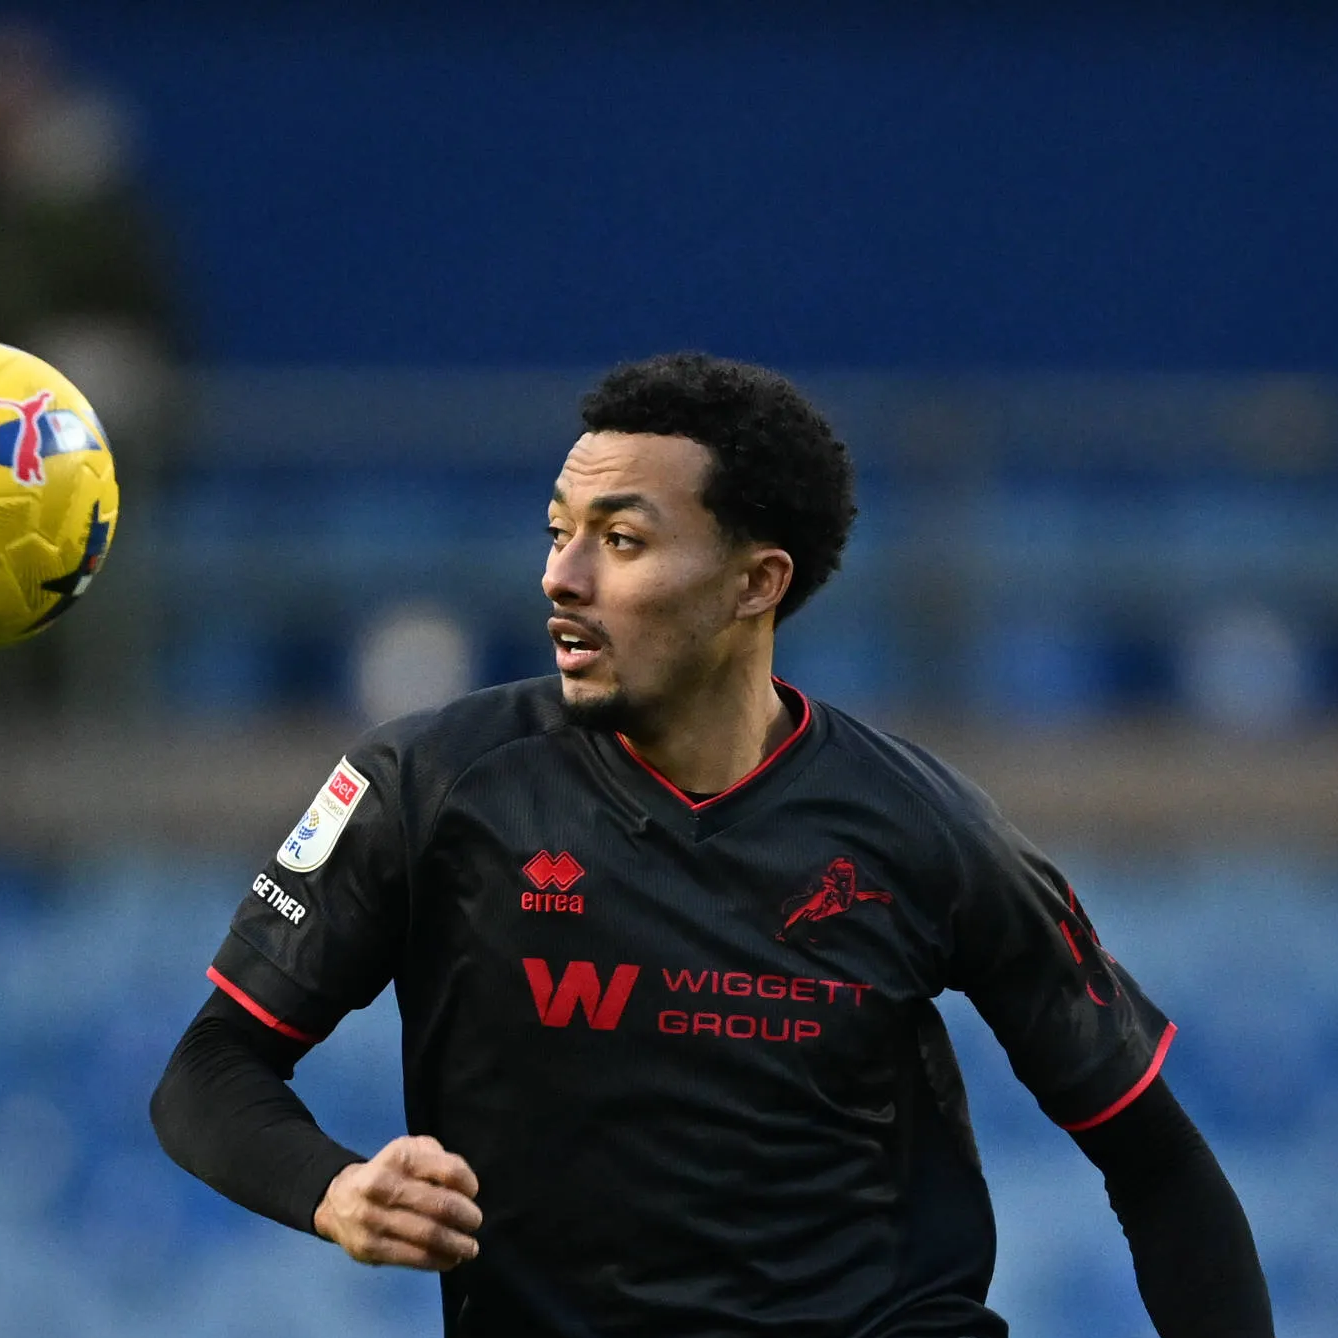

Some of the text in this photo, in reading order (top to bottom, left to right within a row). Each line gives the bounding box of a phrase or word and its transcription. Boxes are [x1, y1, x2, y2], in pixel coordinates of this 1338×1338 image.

[252, 873, 306, 925] GETHER
[662, 967, 874, 1006] WIGGETT
[657, 1010, 822, 1043] GROUP
